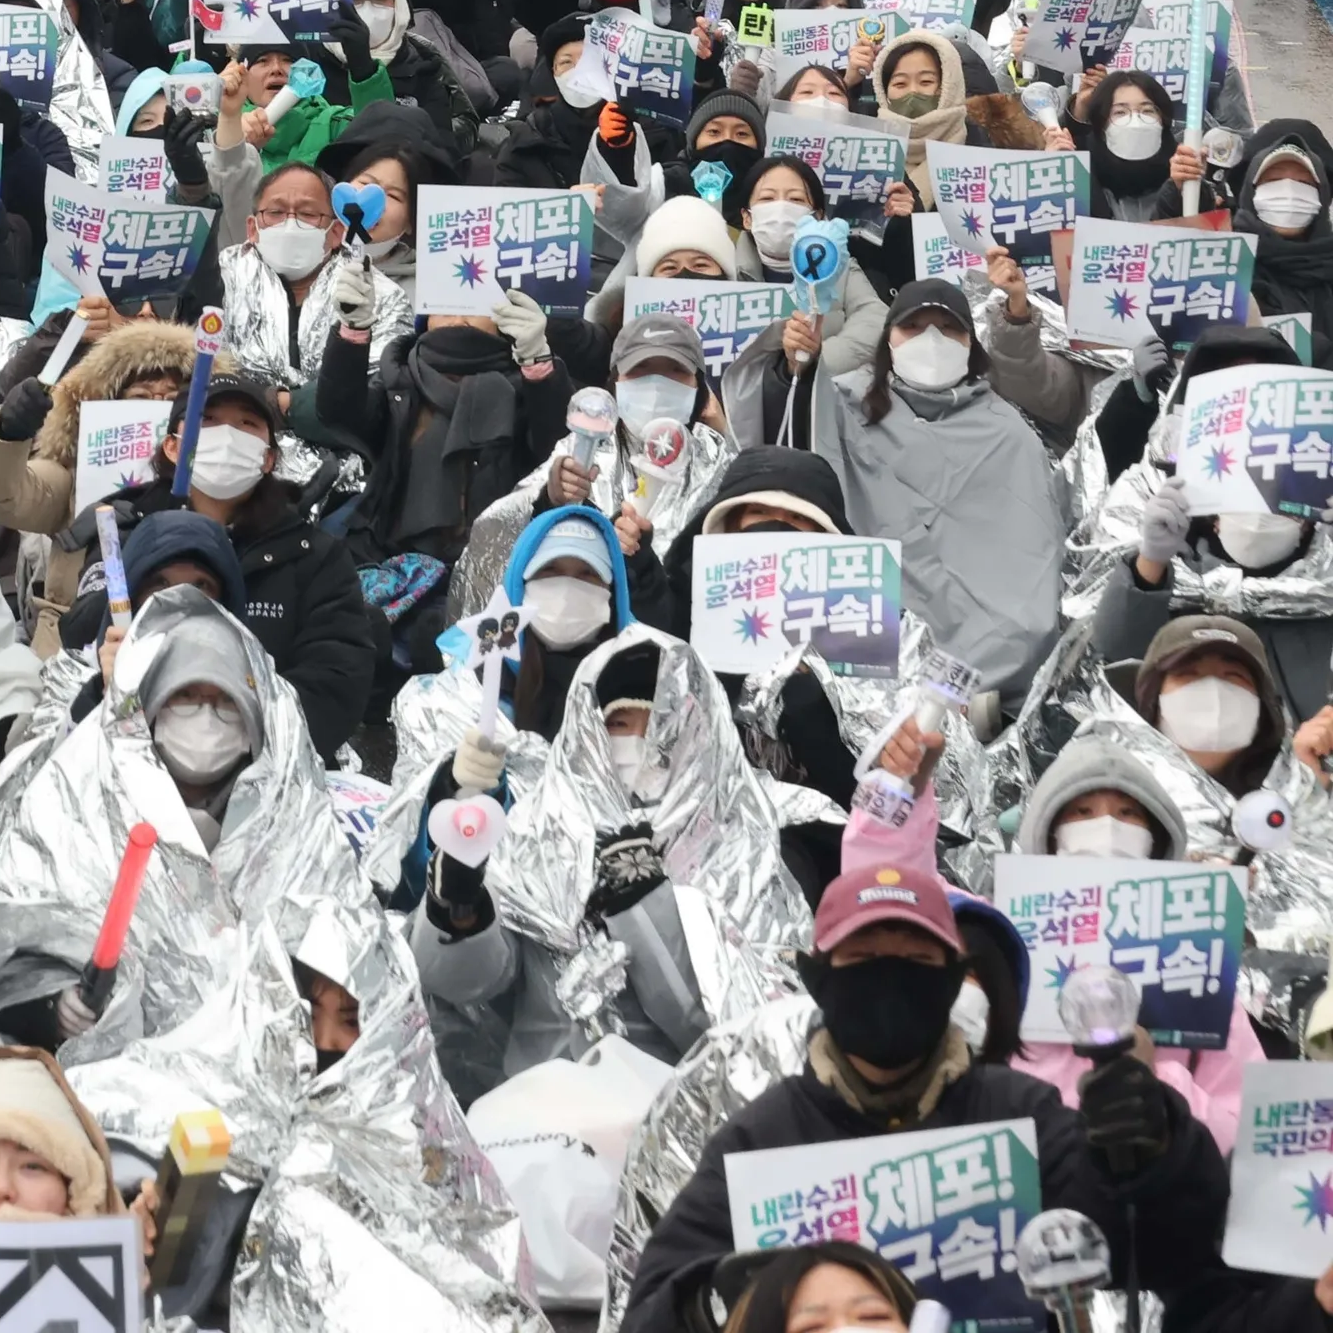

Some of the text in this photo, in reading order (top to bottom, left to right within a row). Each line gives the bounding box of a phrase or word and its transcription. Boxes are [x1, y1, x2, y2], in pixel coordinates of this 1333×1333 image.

[51, 195, 105, 224] 내란수괴
[428, 206, 492, 230] 내란수괴
[496, 200, 581, 244] 체포!
[115, 210, 195, 250] 체포!
[427, 225, 490, 252] 윤석열
[101, 248, 189, 287] 구속!
[496, 242, 577, 282] 구속!
[1083, 243, 1149, 265] 내란수괴
[1083, 258, 1148, 284] 윤석열
[1151, 236, 1239, 284] 체포!
[1149, 280, 1235, 325] 구속!
[87, 422, 151, 446] 내란동조
[87, 441, 151, 467] 국민의힘
[705, 553, 778, 584] 내란수괴
[782, 543, 883, 592] 체포!
[705, 575, 778, 610] 윤석열
[782, 594, 883, 640] 구속!
[1010, 886, 1103, 918] 내란수괴
[1105, 872, 1227, 938] 체포!
[750, 1174, 859, 1228] 내란수괴
[866, 1132, 1013, 1234] 체포!
